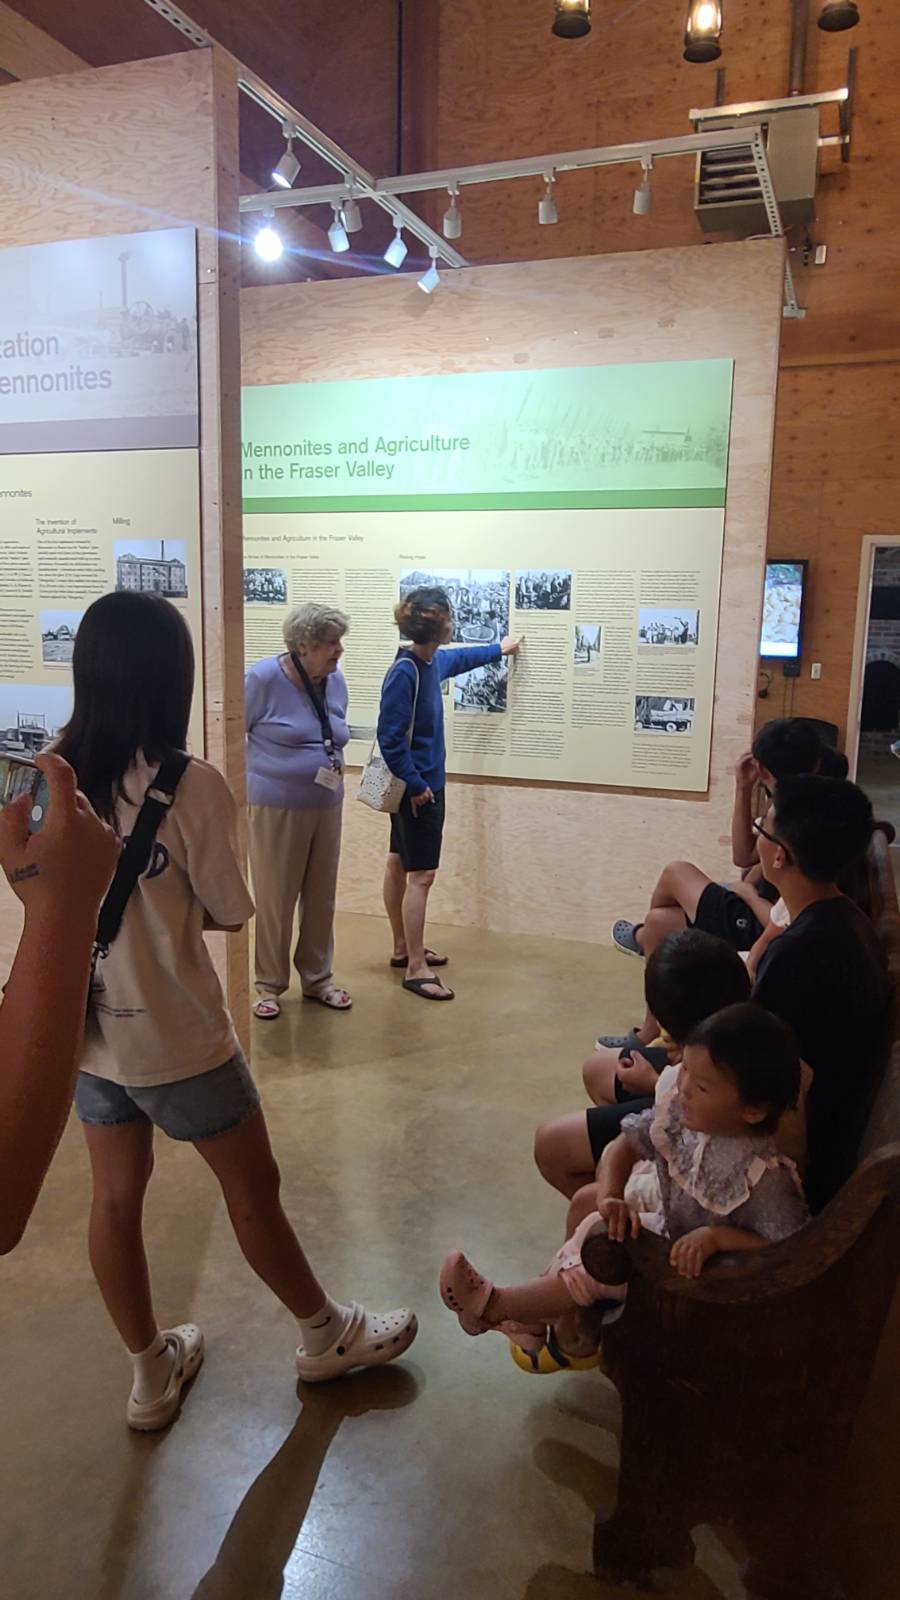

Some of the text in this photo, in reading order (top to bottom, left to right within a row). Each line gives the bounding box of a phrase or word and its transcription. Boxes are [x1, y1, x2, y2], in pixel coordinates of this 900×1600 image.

[0, 331, 59, 359] ation
[241, 434, 471, 458] Mennonites and Agriculture
[243, 460, 395, 481] n the Fraser Valley
